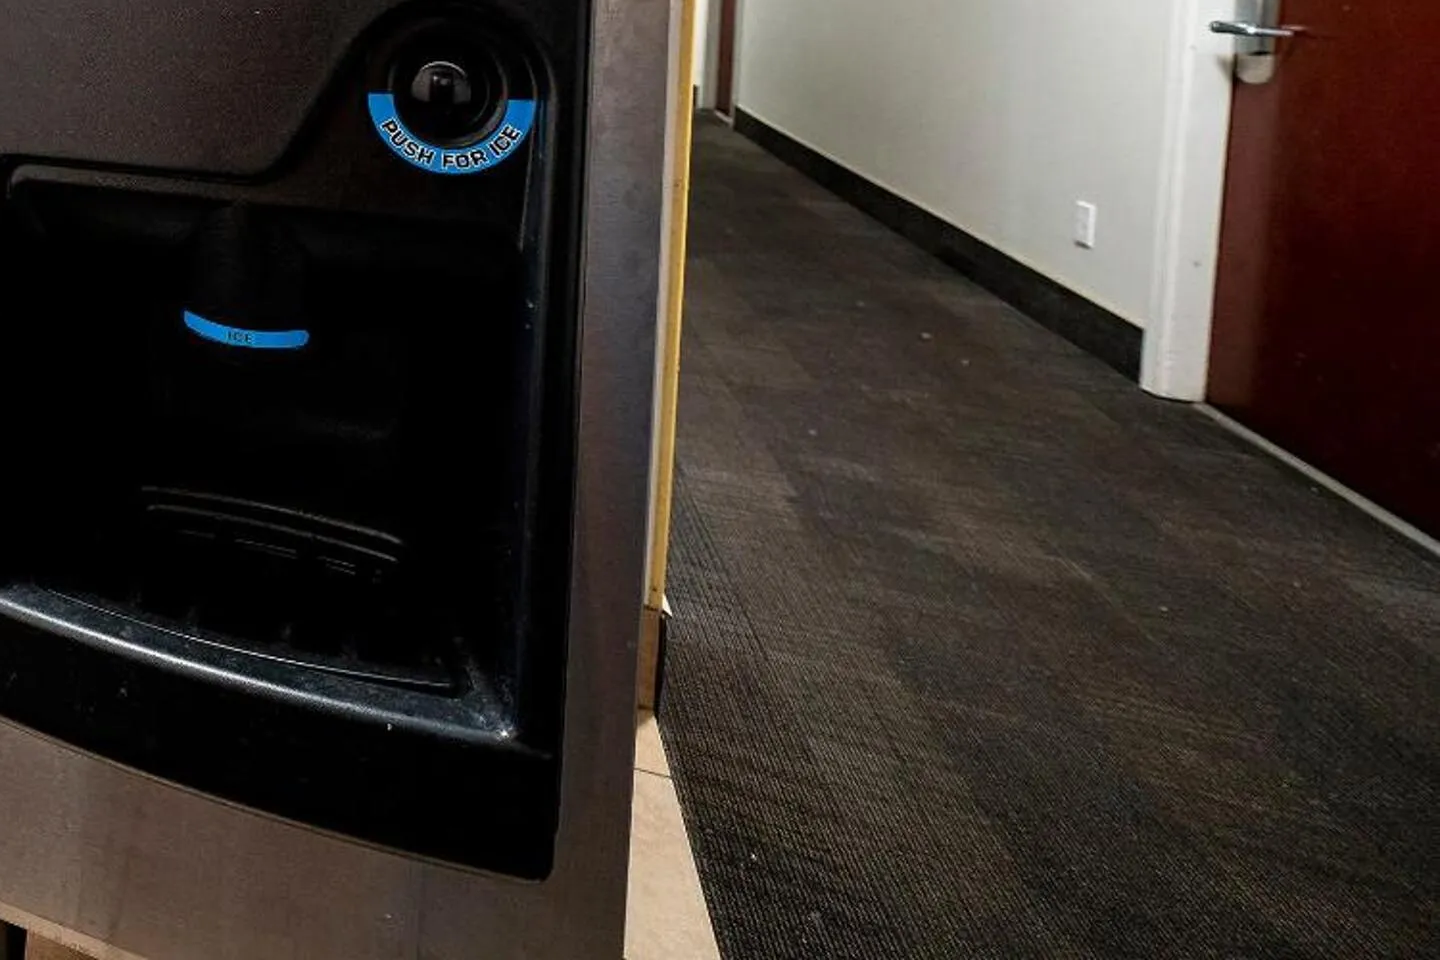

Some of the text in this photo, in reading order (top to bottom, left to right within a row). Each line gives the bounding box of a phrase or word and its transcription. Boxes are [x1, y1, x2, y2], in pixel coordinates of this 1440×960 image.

[381, 116, 523, 170] PUSH FOR ICE
[226, 331, 253, 344] ICE
